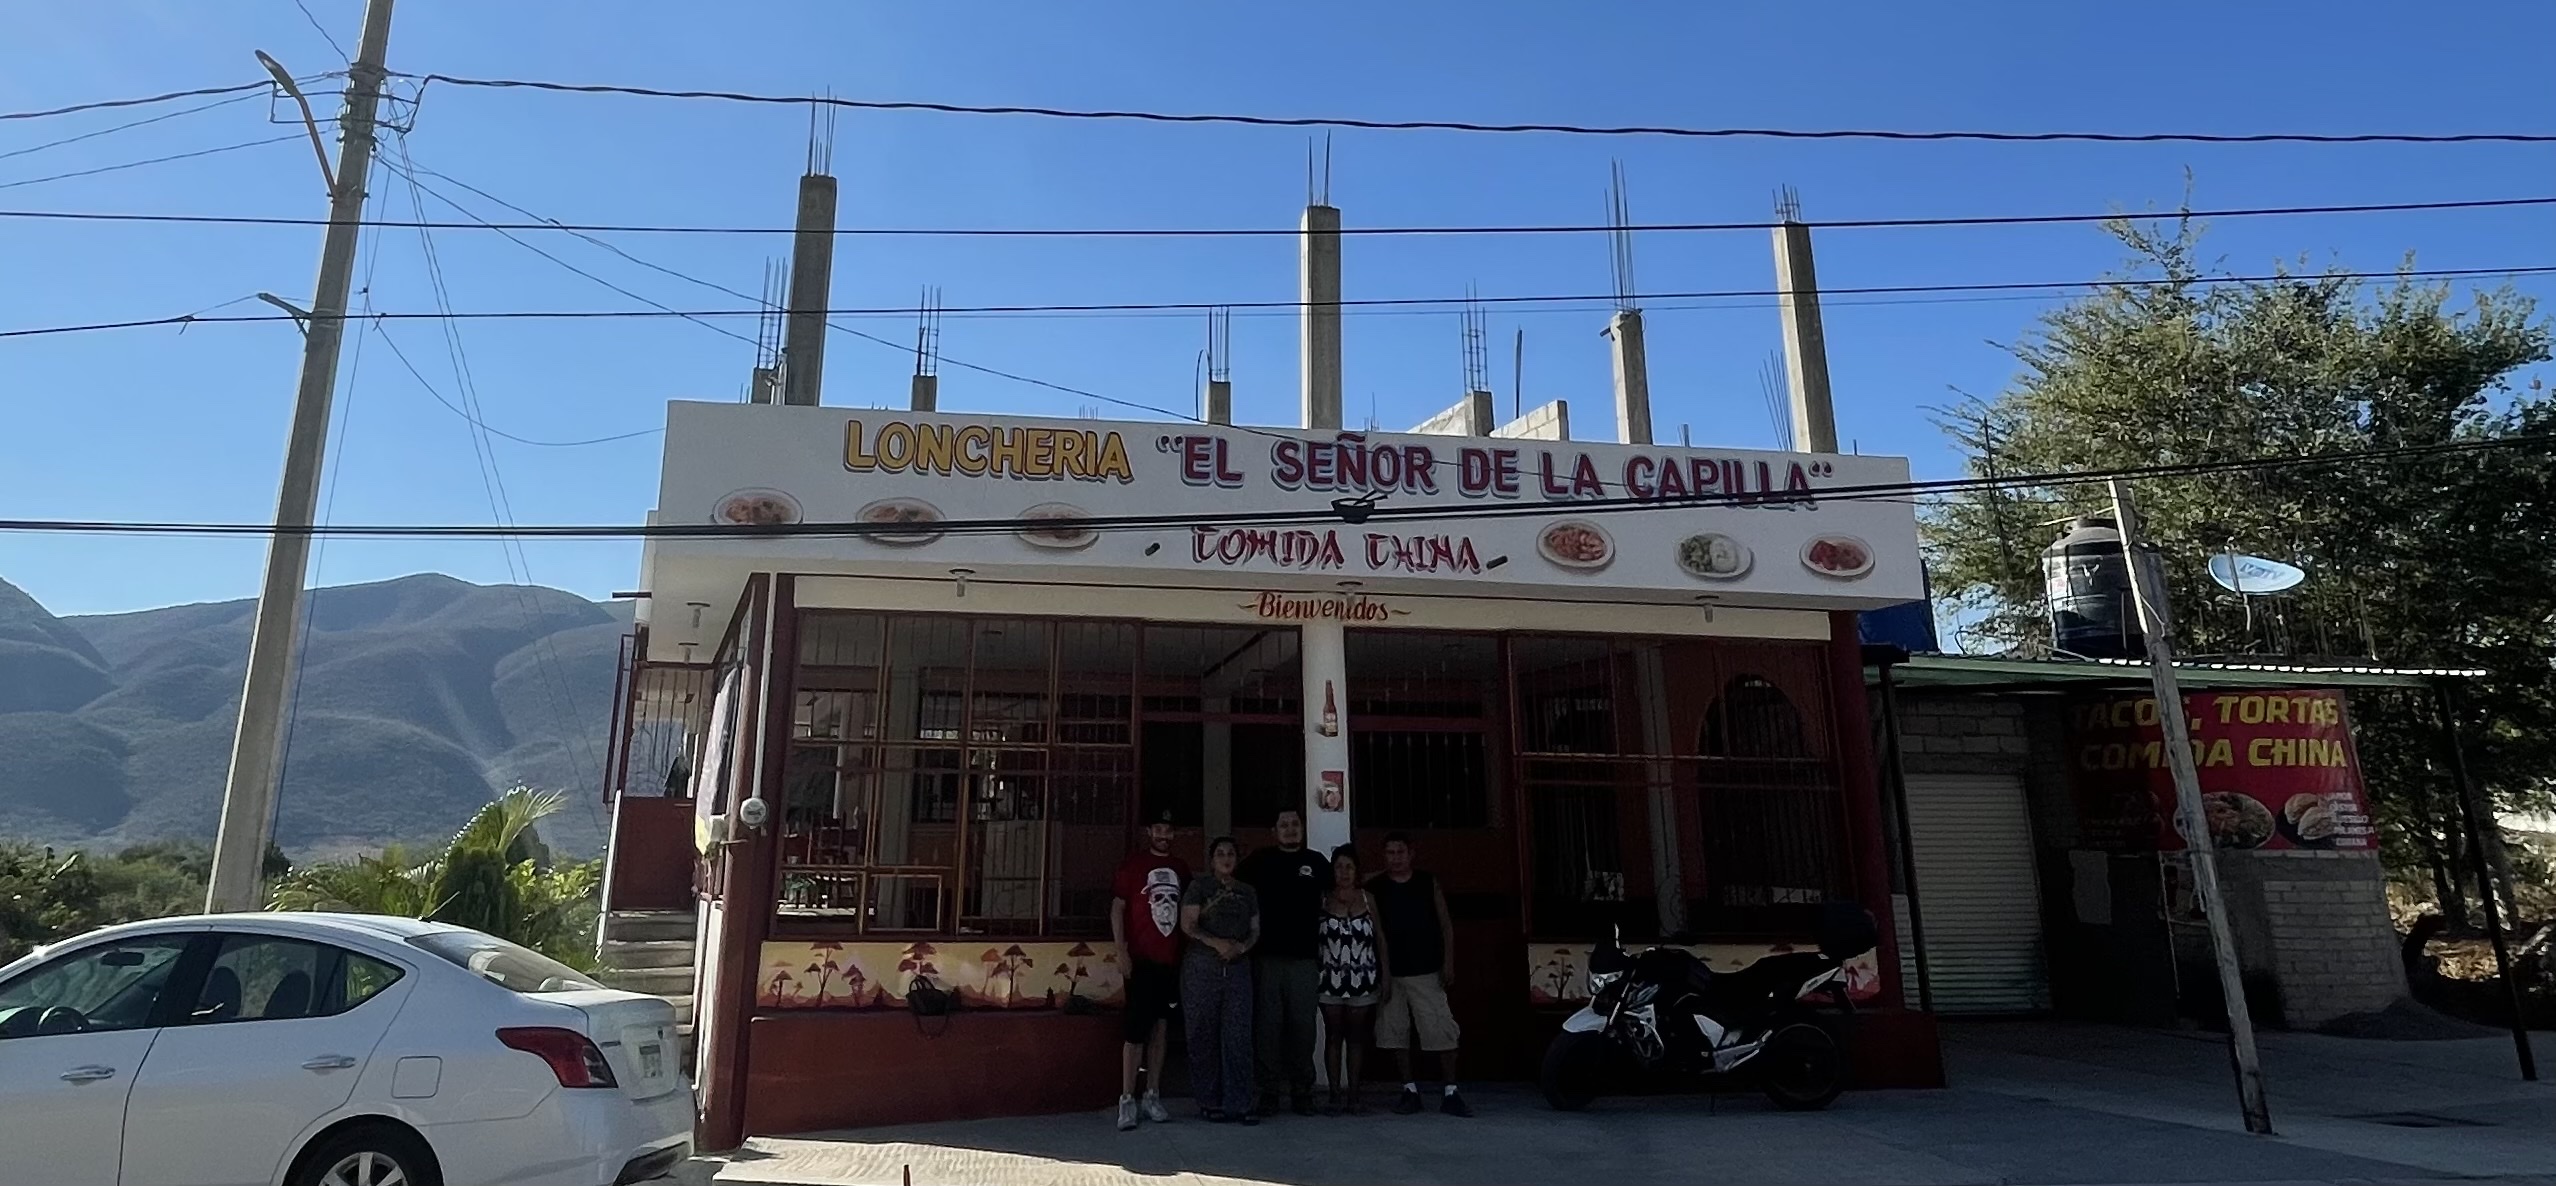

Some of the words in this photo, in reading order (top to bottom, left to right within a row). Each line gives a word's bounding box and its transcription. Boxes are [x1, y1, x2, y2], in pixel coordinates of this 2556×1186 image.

[844, 420, 1134, 485] LONCHERIA
[1271, 431, 1440, 496] SEÑOR
[1457, 446, 1519, 499] DE
[1537, 449, 1607, 499] LA
[1192, 525, 1345, 570] COMIDA
[1364, 532, 1481, 575] CHINA
[1257, 591, 1389, 622] Bienvenidos
[2072, 697, 2203, 731] TACO,
[2211, 695, 2340, 727] TORTAS
[2248, 737, 2349, 768] CHINA
